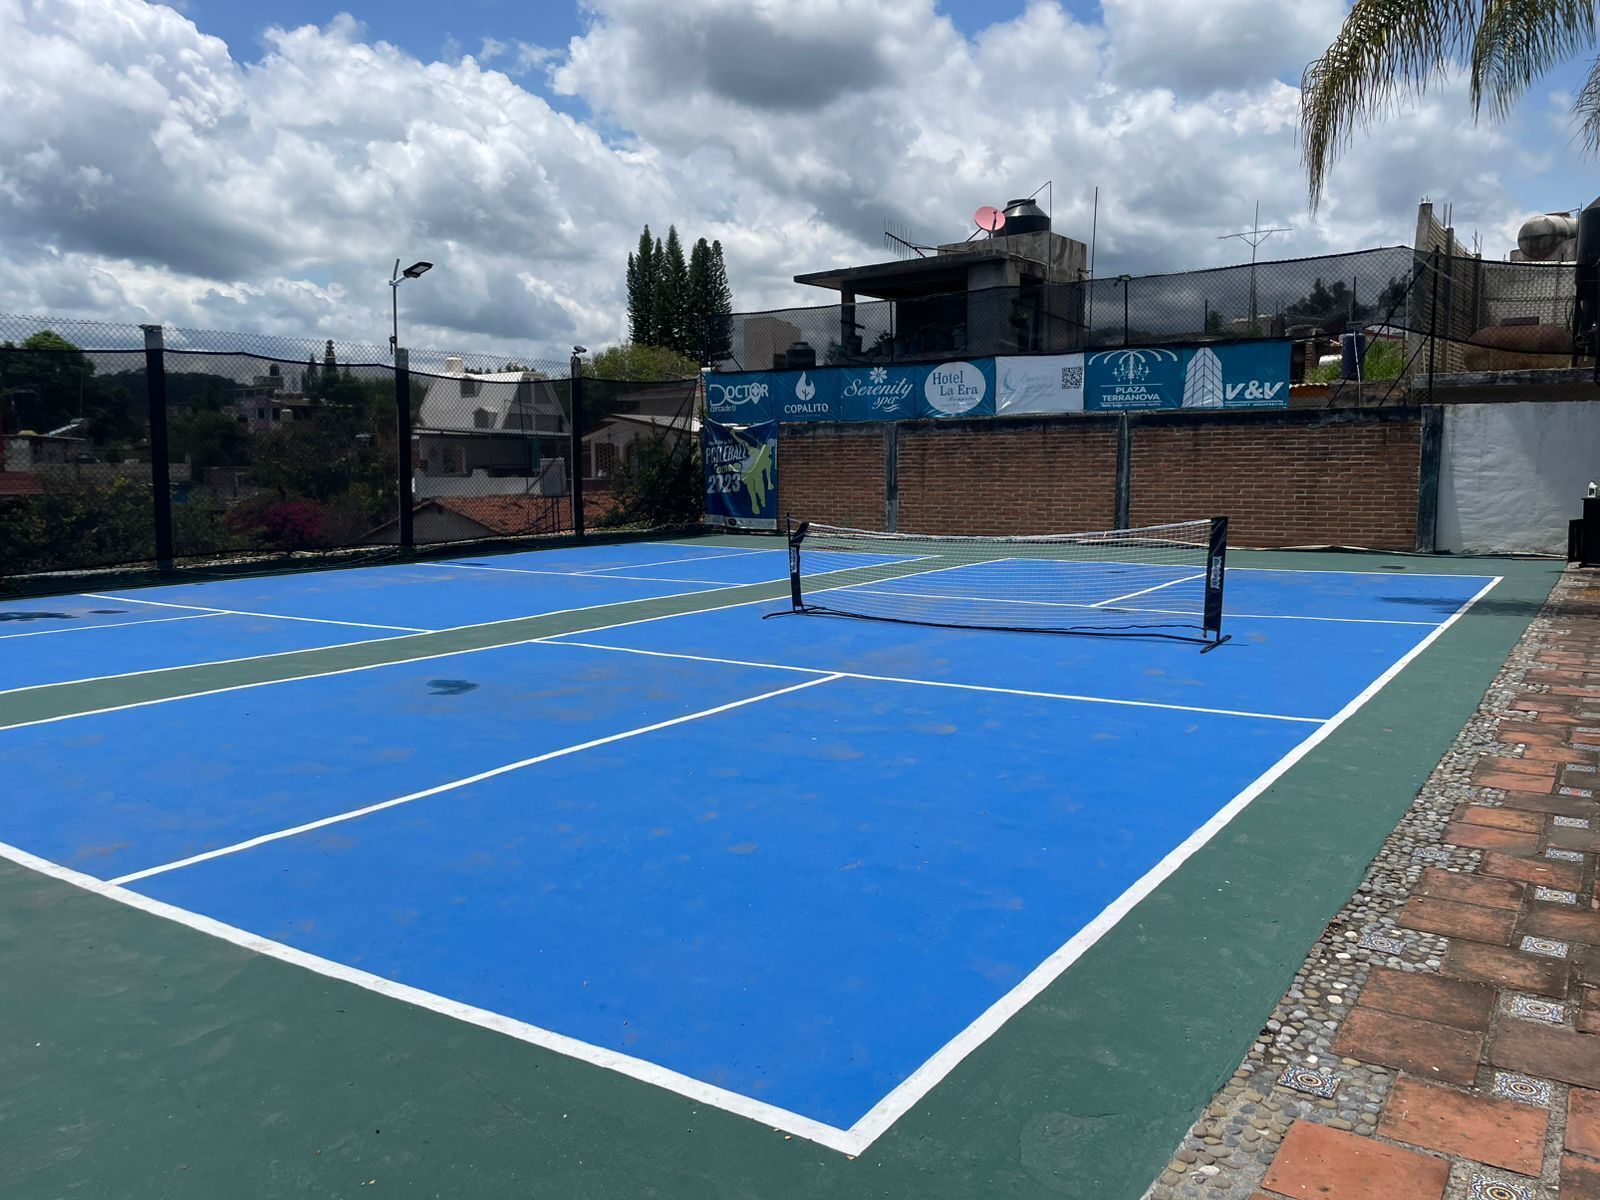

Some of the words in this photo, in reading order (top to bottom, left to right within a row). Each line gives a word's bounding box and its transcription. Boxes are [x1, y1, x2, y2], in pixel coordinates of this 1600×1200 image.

[932, 371, 963, 385] Hotel
[709, 382, 769, 406] DOCTOR
[844, 378, 913, 399] Serenity
[940, 386, 954, 396] La
[957, 385, 978, 395] Era
[1115, 386, 1147, 394] PLAZA
[872, 396, 899, 409] spa
[1101, 394, 1160, 402] TERRANOVA
[784, 403, 829, 414] COPALITO
